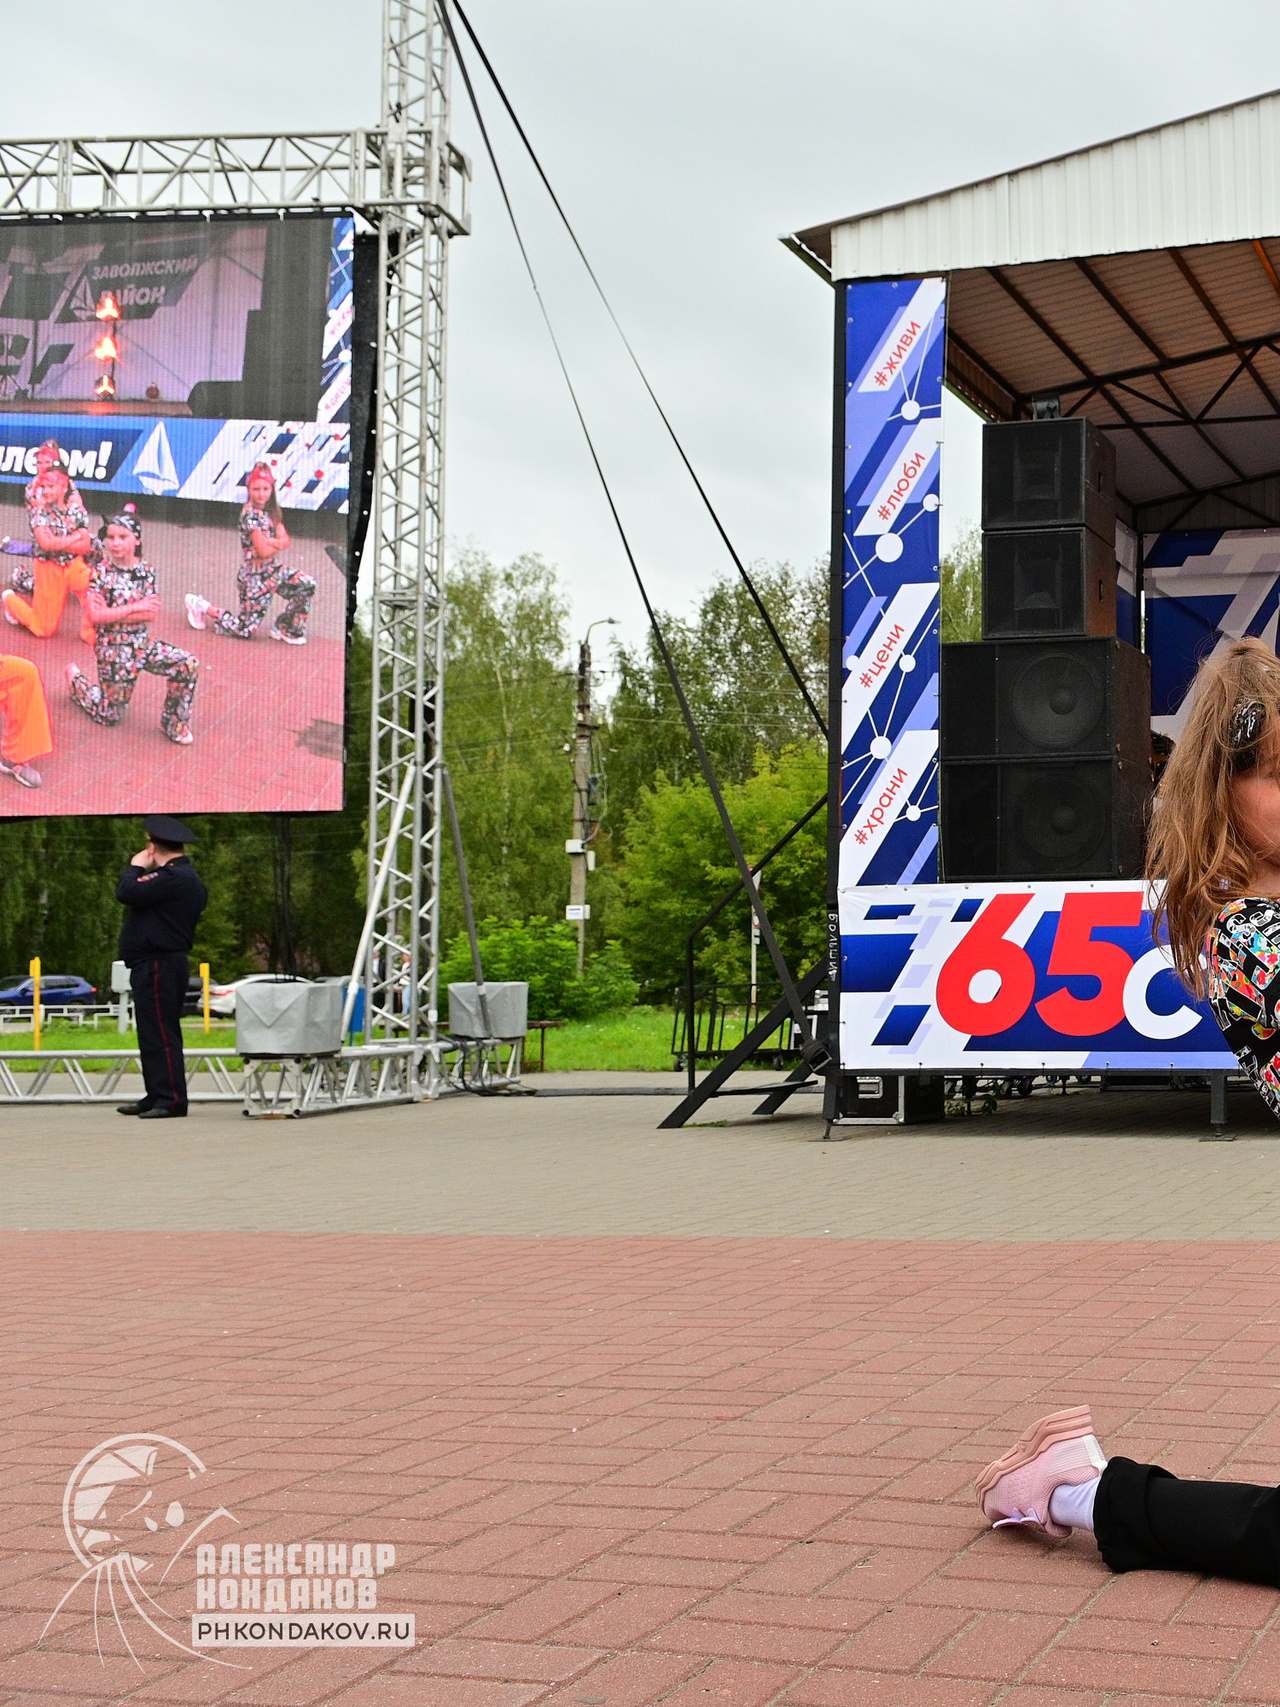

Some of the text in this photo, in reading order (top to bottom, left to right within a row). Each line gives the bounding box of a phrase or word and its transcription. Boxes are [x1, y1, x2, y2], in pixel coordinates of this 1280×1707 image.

[91, 254, 198, 280] ЗАВОЛЖСКИЙ
[874, 321, 921, 387] #живи
[877, 452, 926, 521] #люби
[859, 623, 905, 689] #цени
[854, 767, 909, 846] #храни
[936, 891, 1145, 1037] 65
